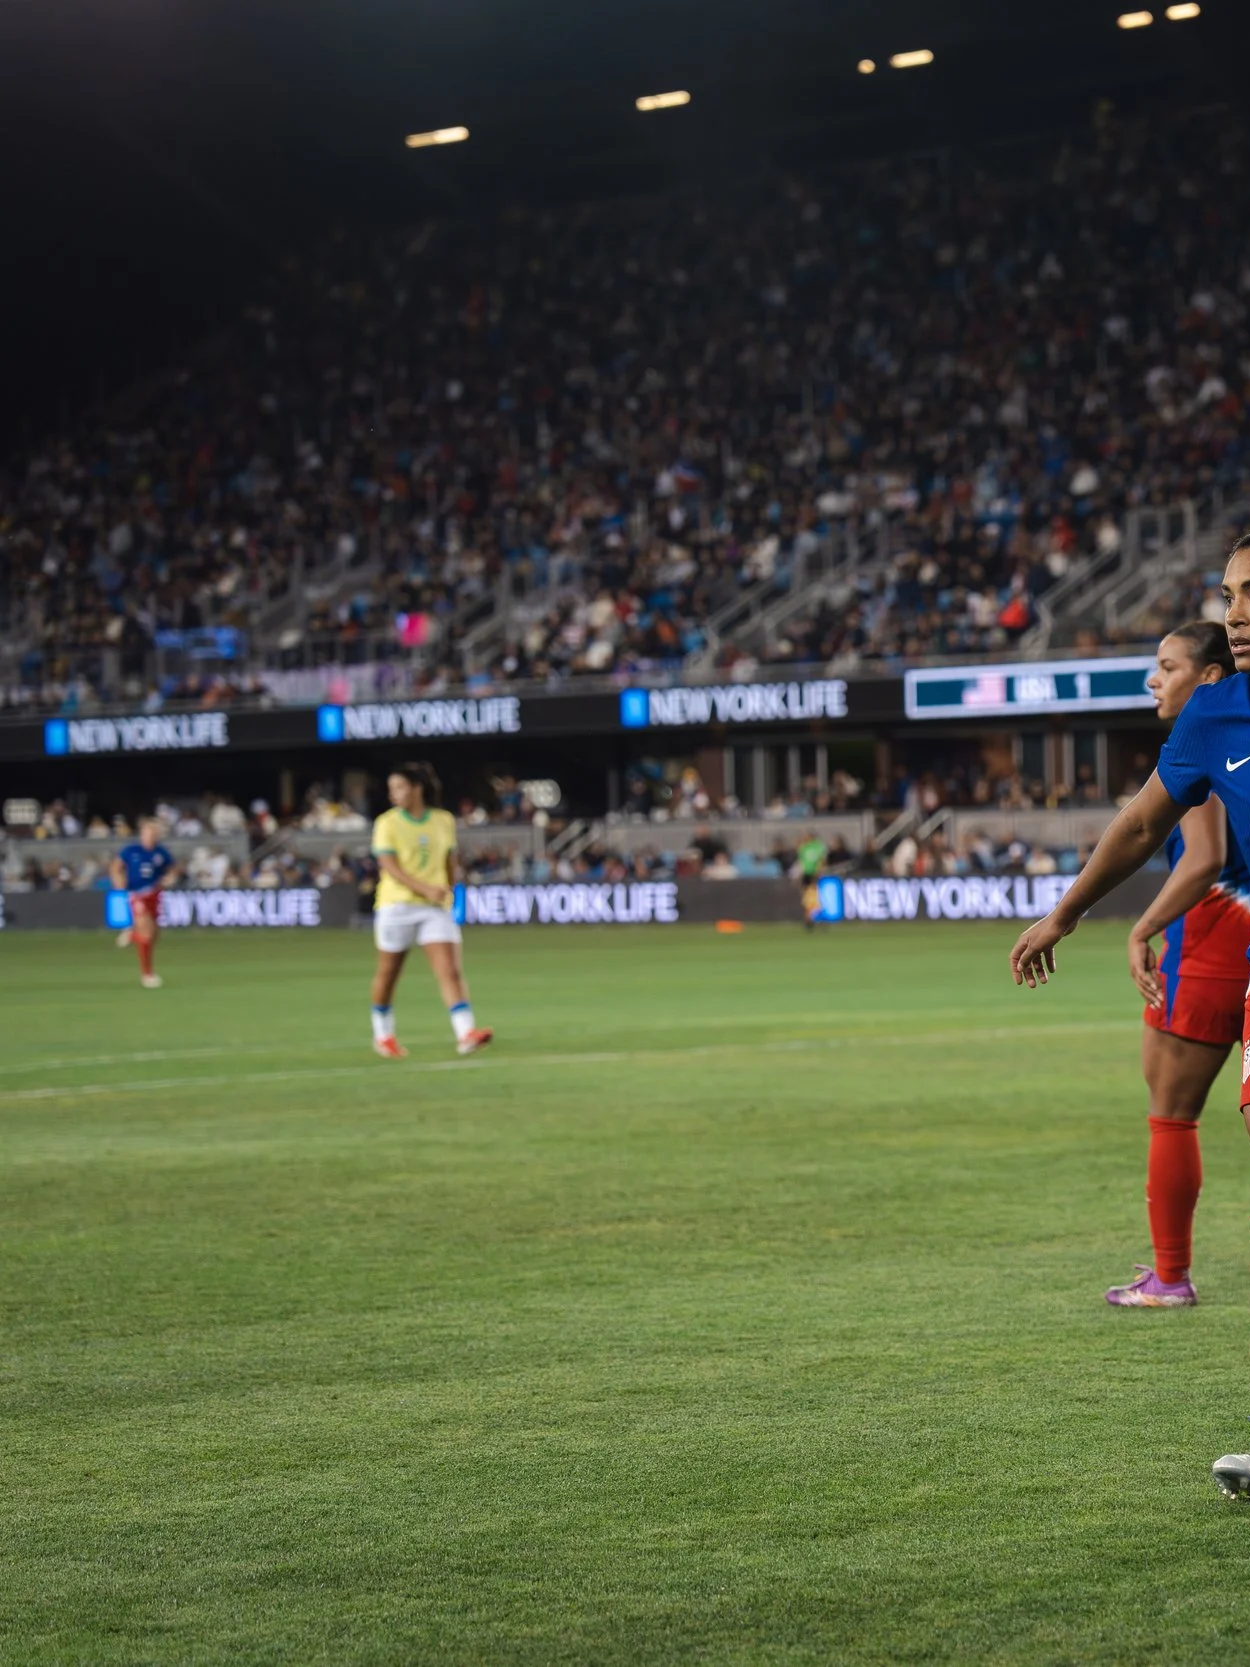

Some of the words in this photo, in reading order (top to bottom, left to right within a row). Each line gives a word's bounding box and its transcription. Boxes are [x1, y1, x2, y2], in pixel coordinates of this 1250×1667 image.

[344, 704, 399, 740] NEW
[398, 700, 466, 737] YORK
[466, 697, 521, 733] LIFE
[649, 687, 713, 725] NEW
[711, 683, 787, 722] YORK
[787, 679, 848, 719] LIFE
[69, 719, 118, 752] NEW
[116, 715, 178, 750] YORK
[178, 712, 230, 748] LIFE
[190, 890, 265, 927] YORK
[265, 889, 321, 926] LIFE
[466, 885, 532, 924] NEW
[532, 884, 614, 924] YORK
[613, 883, 679, 923] LIFE
[844, 877, 921, 920] NEW
[919, 876, 1014, 919] YORK
